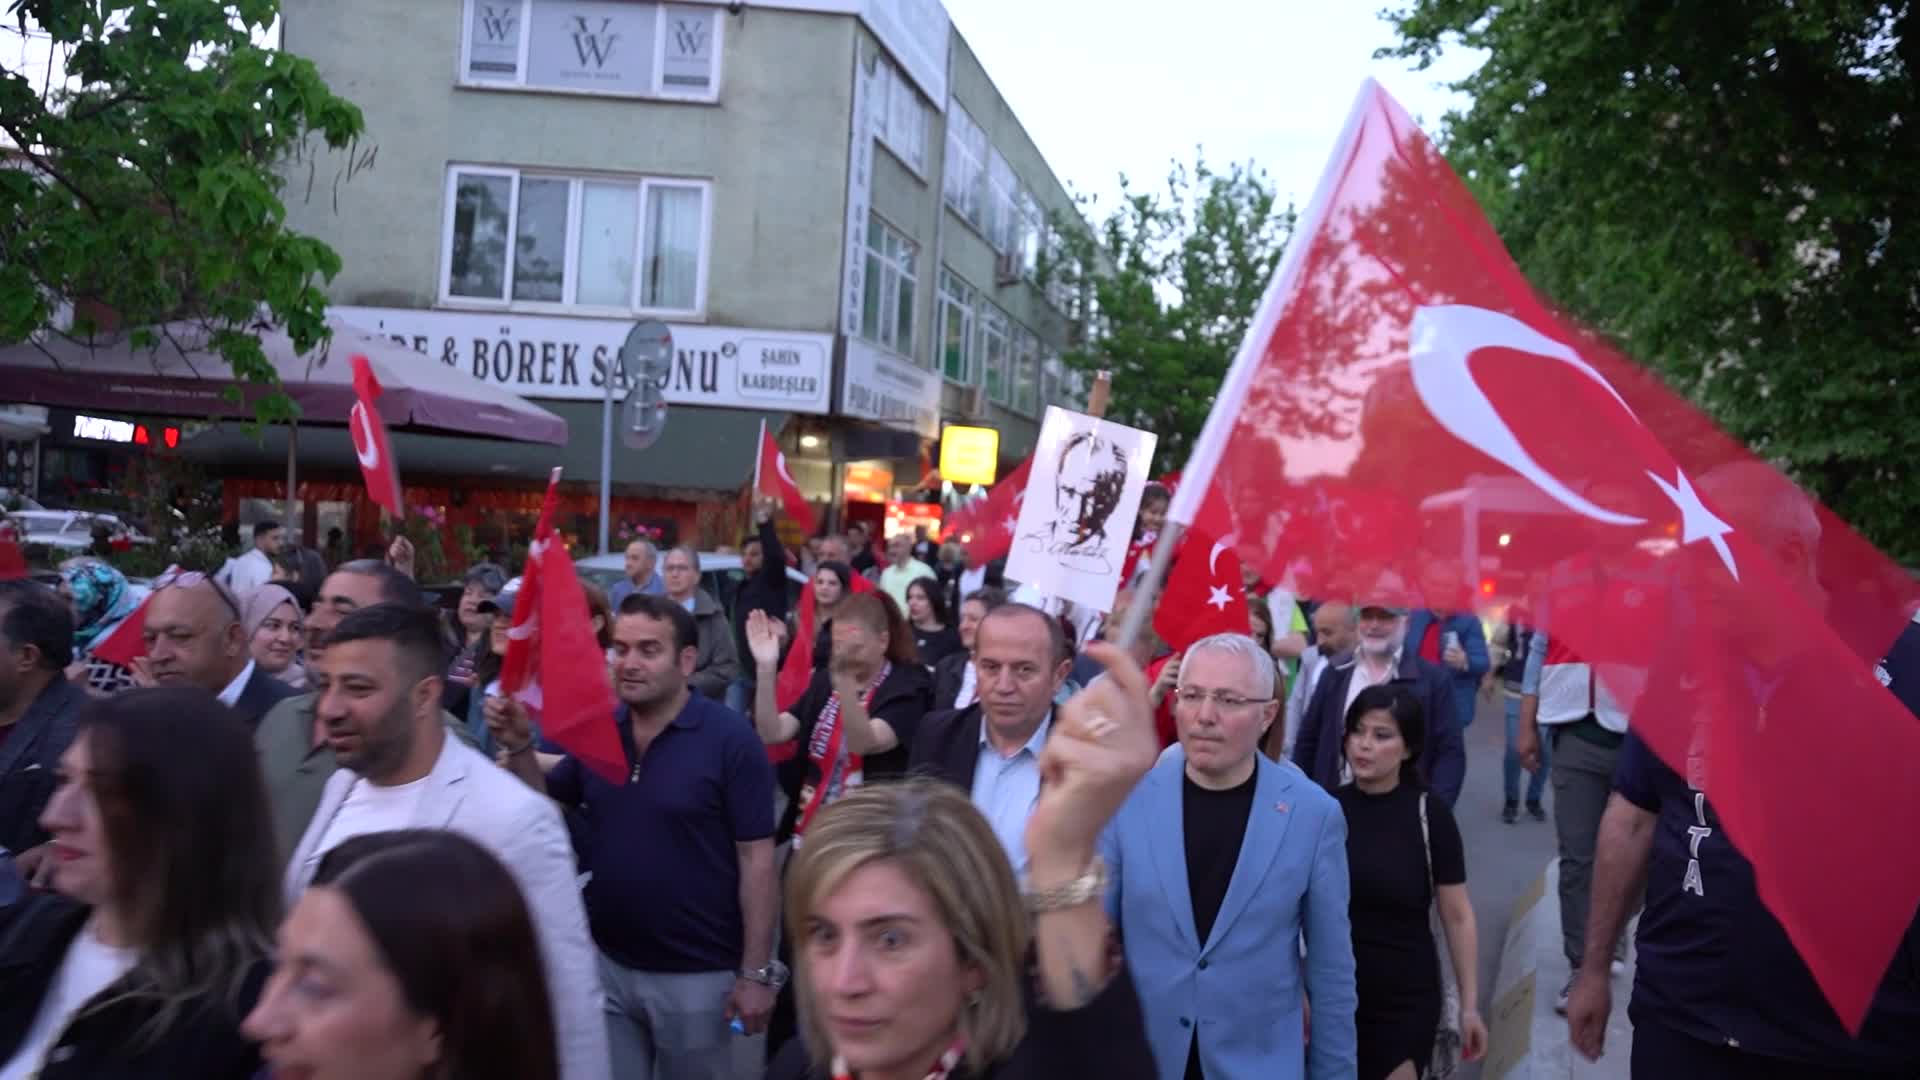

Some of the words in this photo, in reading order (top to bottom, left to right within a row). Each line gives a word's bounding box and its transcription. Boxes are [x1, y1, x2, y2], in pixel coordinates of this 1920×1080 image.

[472, 325, 580, 387] BÖREK
[590, 345, 720, 393] SANU
[742, 374, 817, 396] KARDEŞLER
